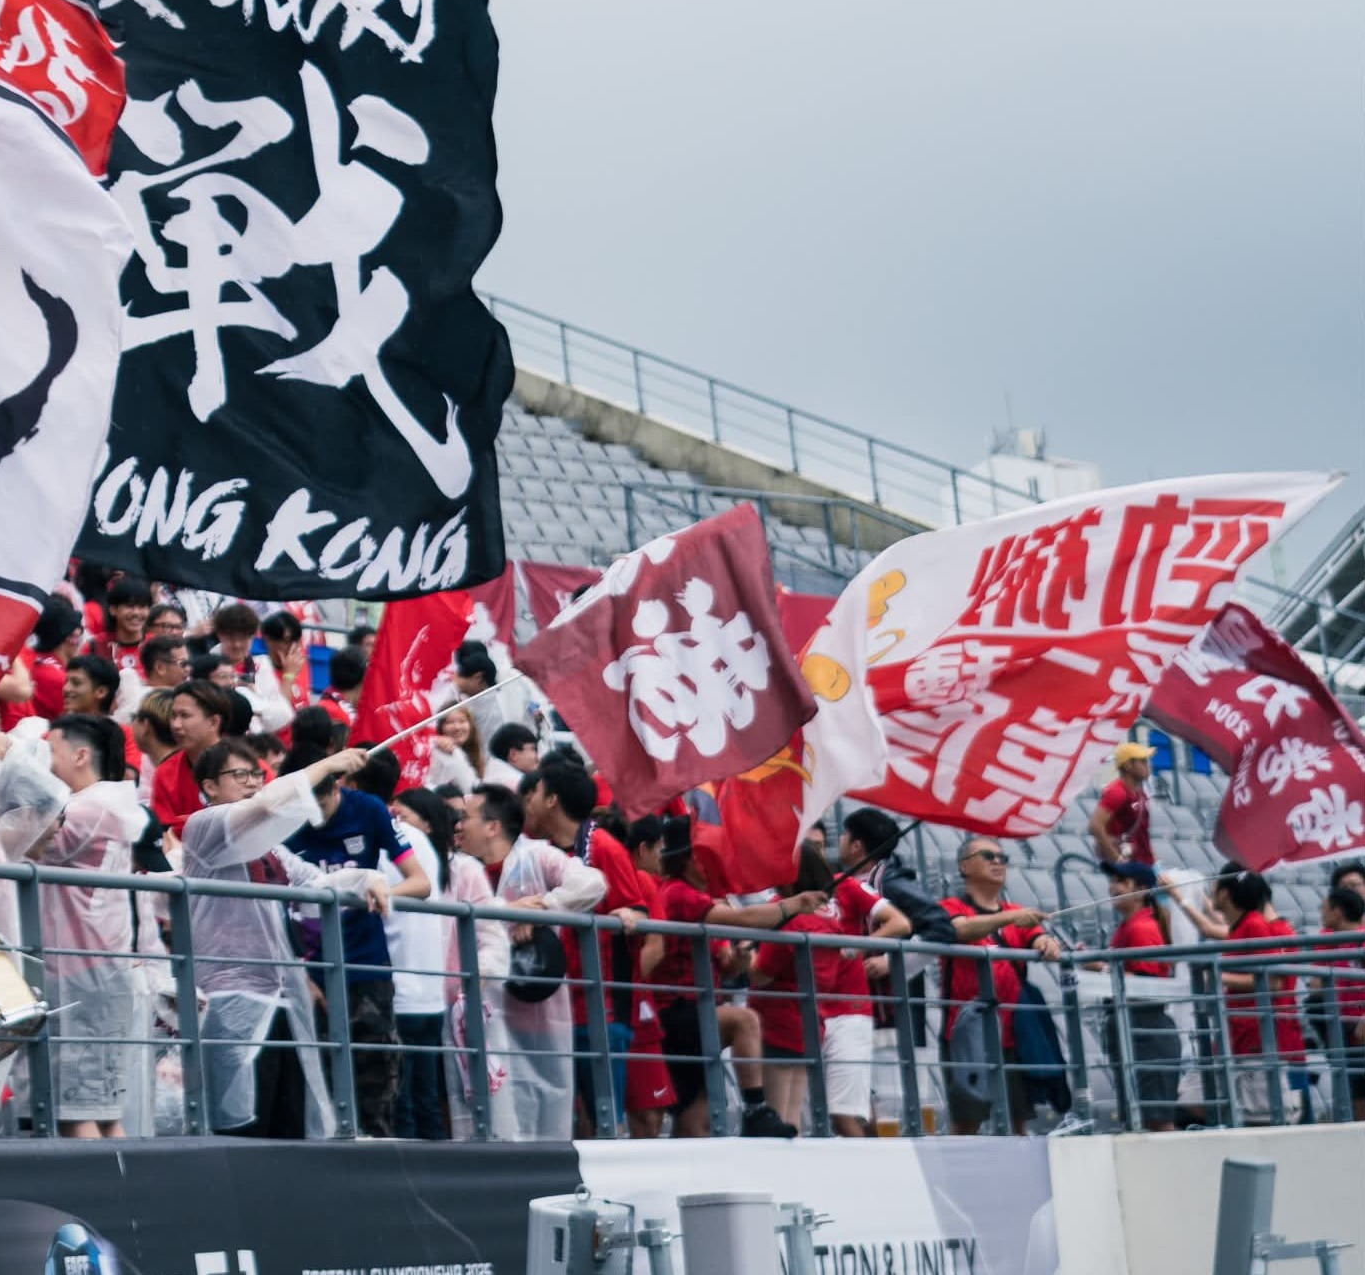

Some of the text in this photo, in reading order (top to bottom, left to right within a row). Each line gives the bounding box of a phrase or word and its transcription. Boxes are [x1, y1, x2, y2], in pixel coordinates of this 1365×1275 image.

[108, 60, 472, 499] 戰
[93, 442, 250, 561] ONG
[254, 487, 470, 591] KONG
